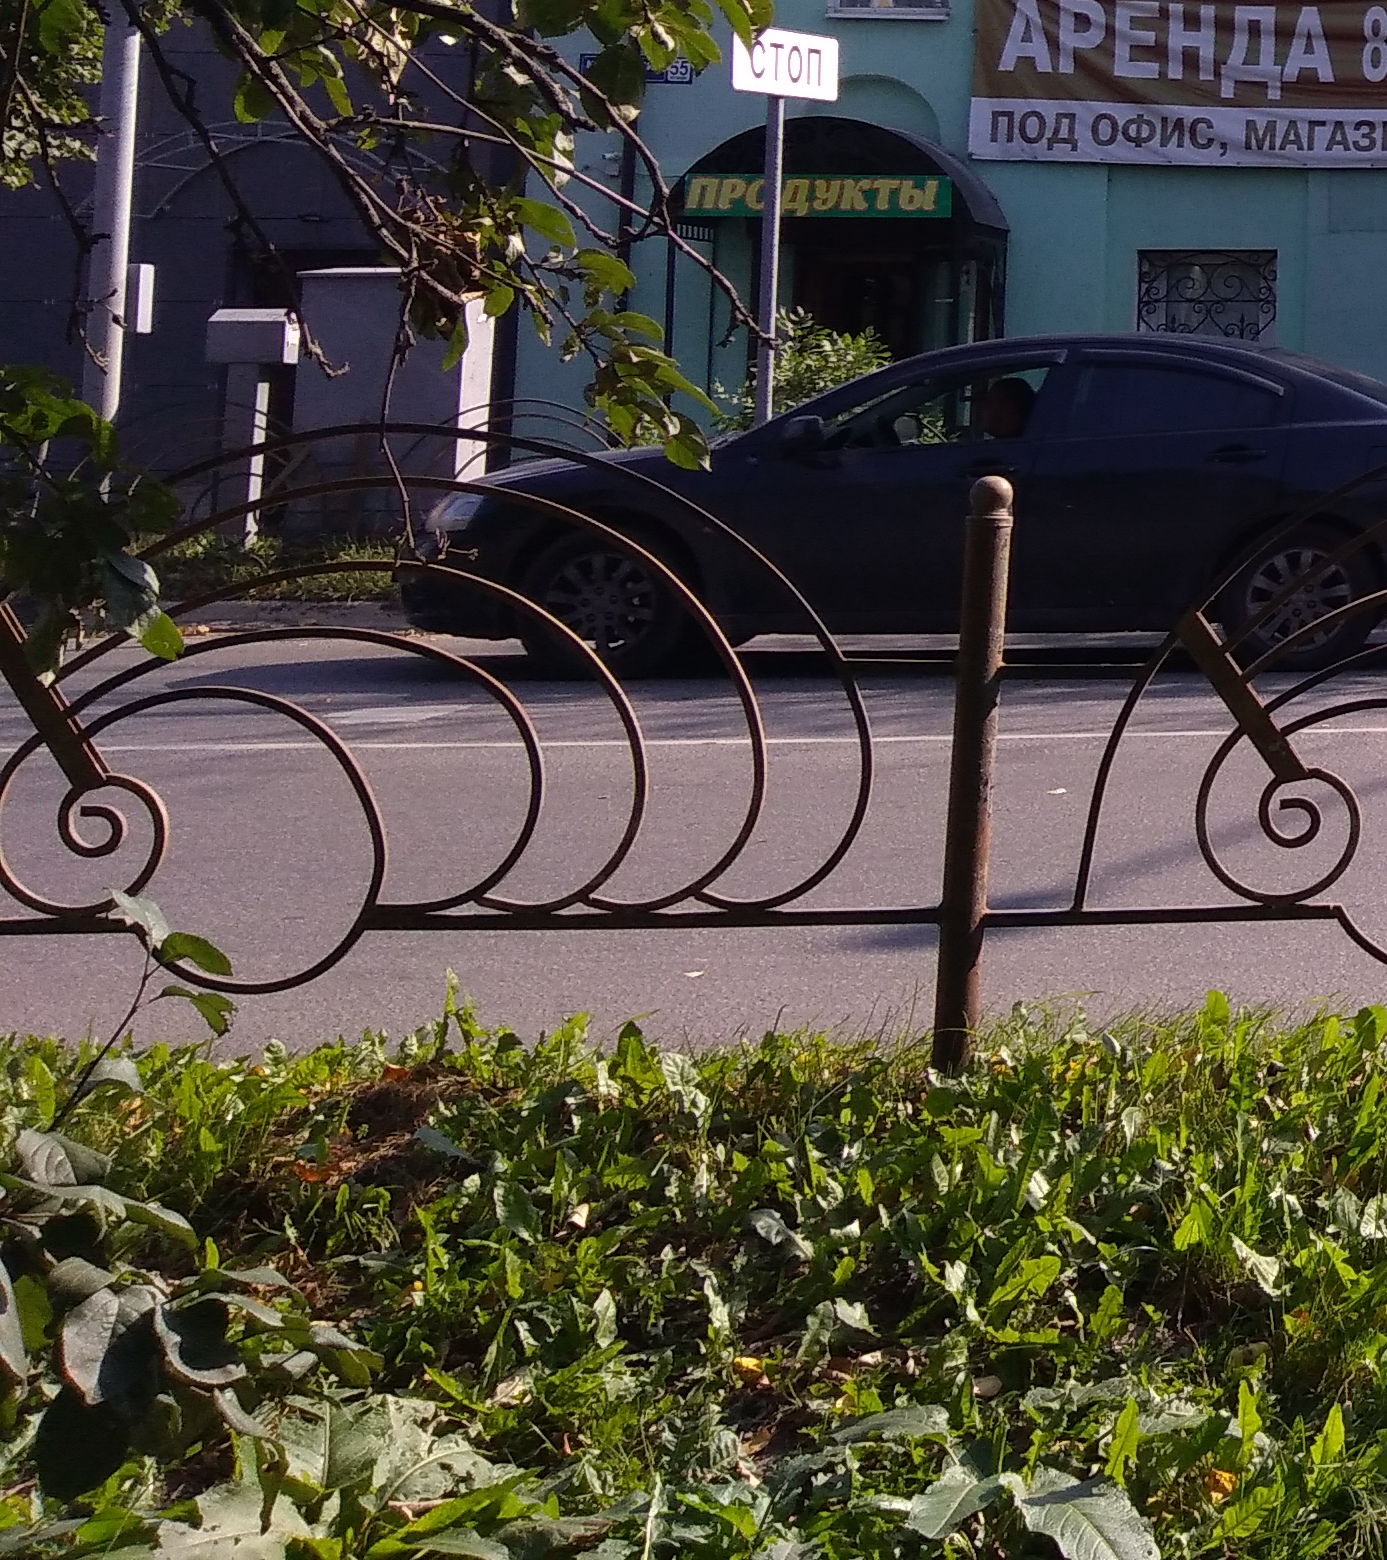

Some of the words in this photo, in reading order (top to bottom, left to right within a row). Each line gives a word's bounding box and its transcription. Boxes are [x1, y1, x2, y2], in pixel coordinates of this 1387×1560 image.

[750, 39, 822, 87] СТОП
[989, 110, 1079, 152] ПОД
[1091, 113, 1228, 157] ОФИС,
